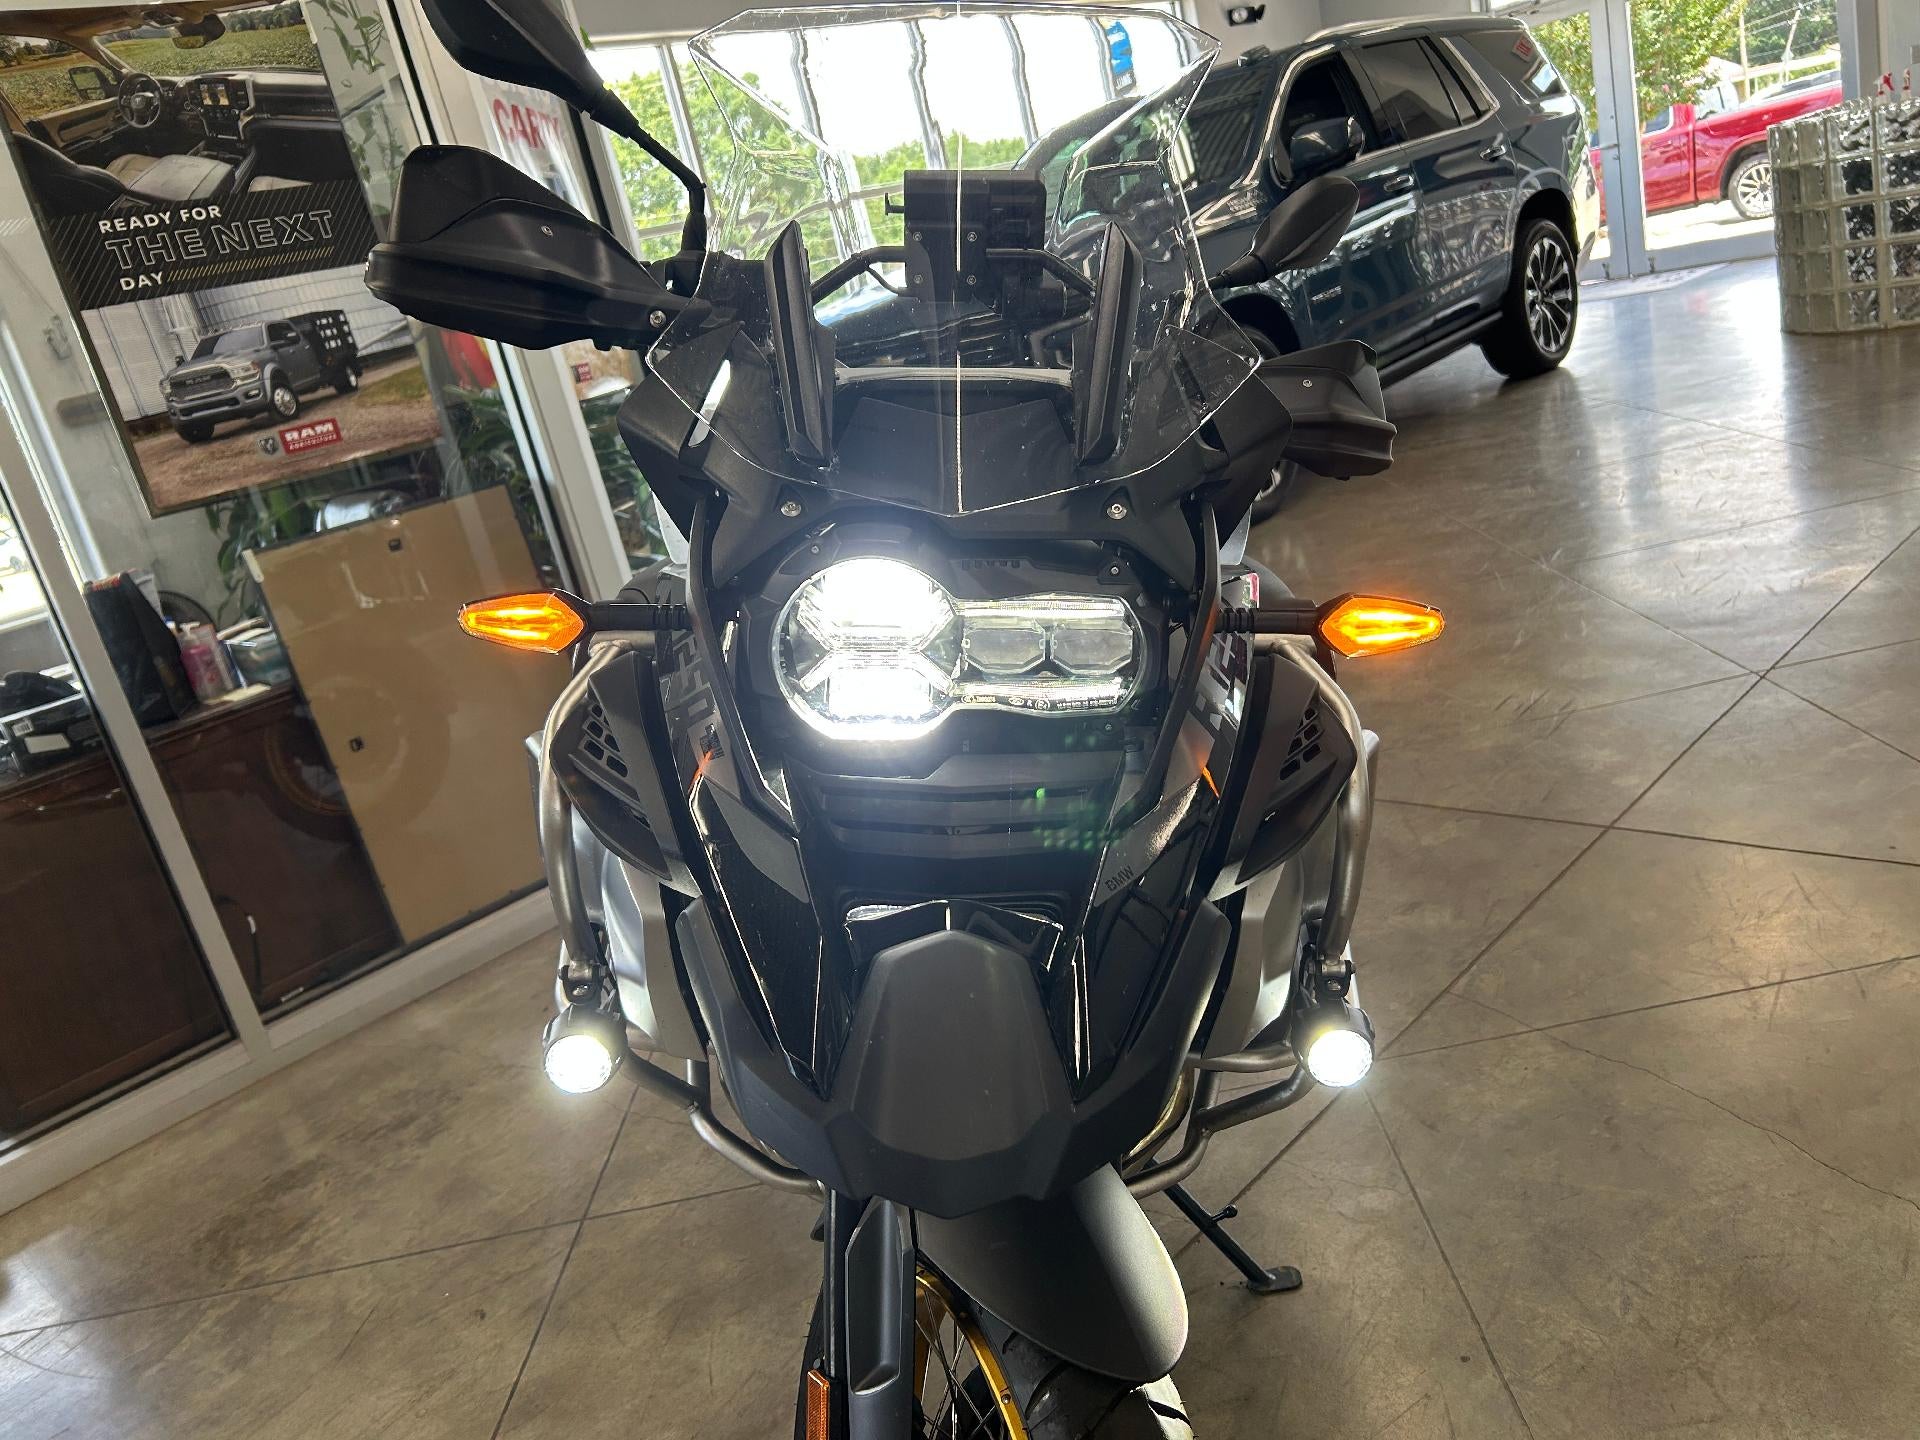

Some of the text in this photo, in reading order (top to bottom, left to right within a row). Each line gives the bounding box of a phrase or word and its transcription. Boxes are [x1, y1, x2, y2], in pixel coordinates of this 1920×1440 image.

[98, 204, 223, 235] READY FOR
[104, 209, 333, 271] THE NEXT
[119, 271, 165, 292] DAY
[284, 422, 335, 442] RAM
[1104, 865, 1134, 891] BMW
